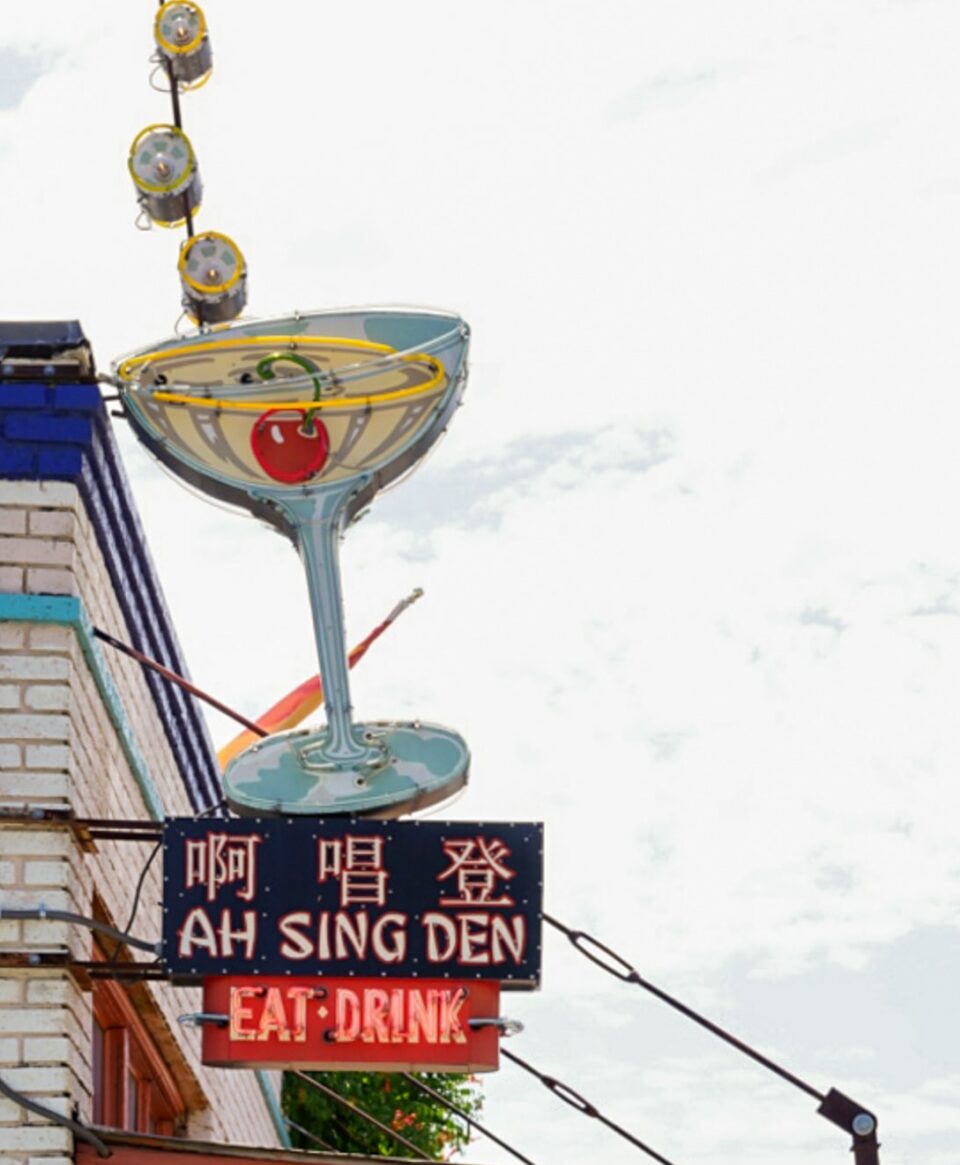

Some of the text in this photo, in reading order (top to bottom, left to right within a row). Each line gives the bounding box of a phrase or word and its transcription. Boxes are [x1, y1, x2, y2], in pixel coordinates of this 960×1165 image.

[178, 907, 527, 965] AH SING DEN
[229, 986, 468, 1044] EAT DRINK
